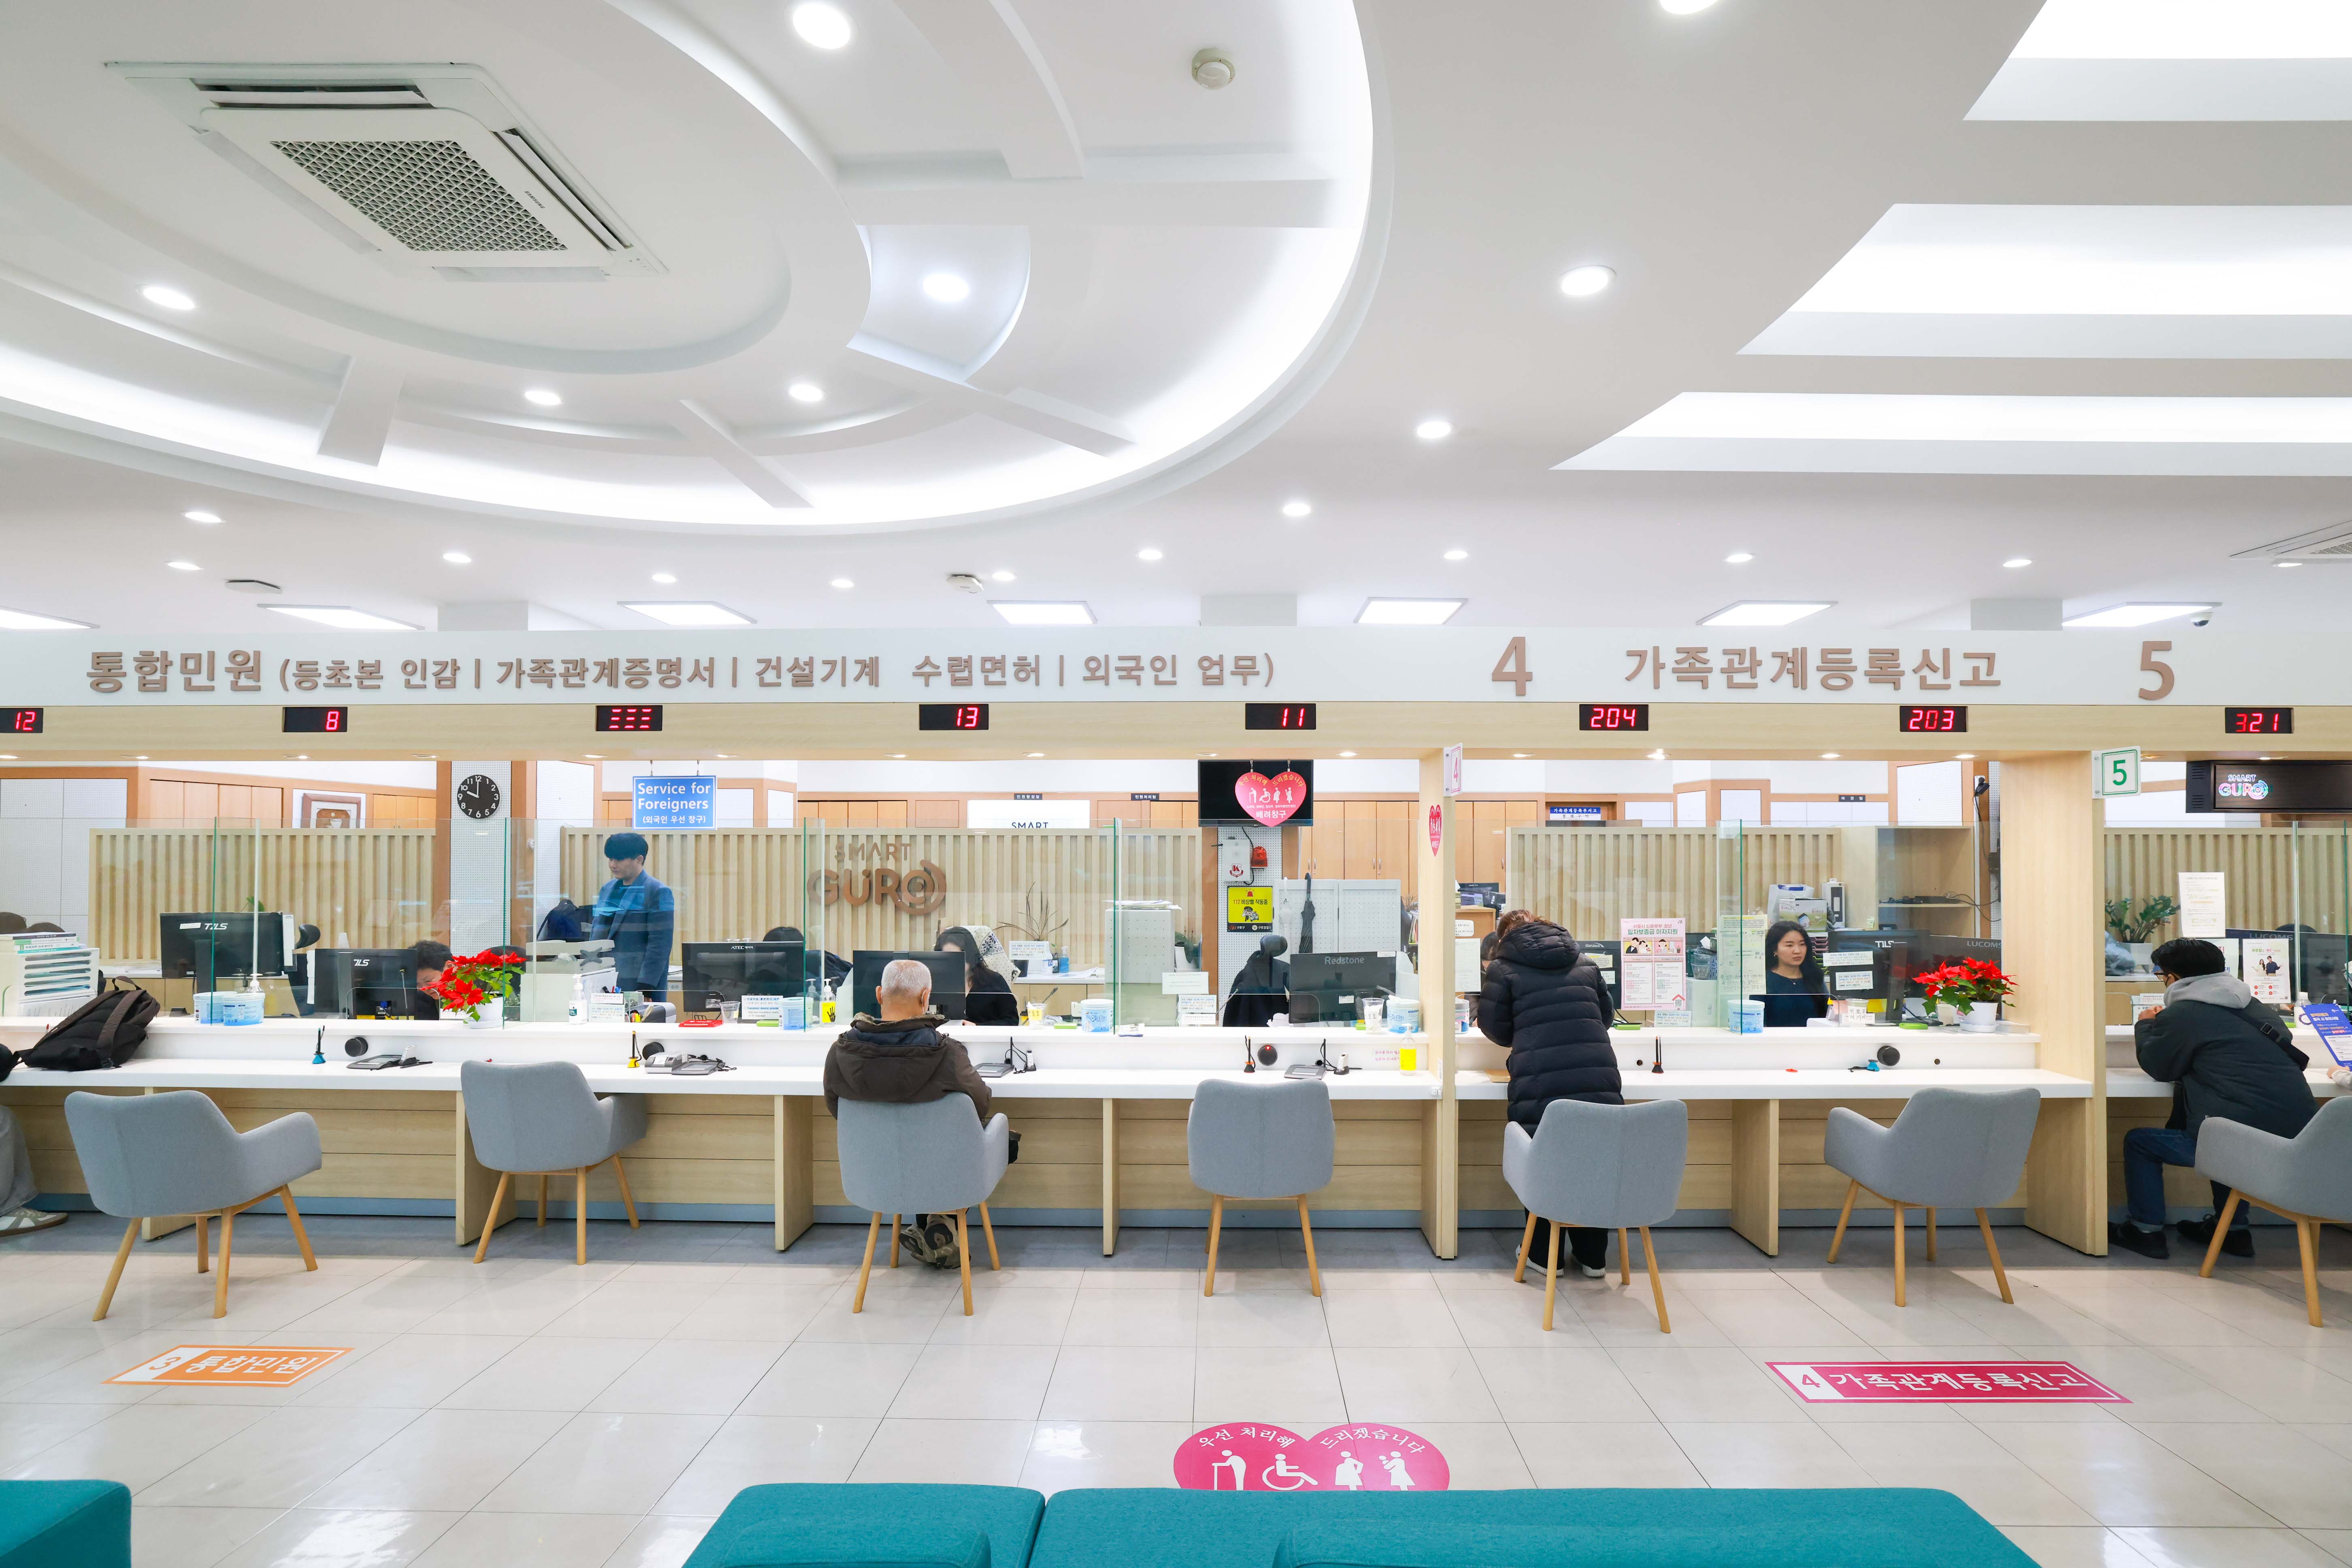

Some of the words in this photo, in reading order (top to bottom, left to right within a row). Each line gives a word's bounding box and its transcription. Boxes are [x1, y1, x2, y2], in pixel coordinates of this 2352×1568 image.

[87, 650, 261, 692] 통합민원
[280, 658, 383, 691] (등초본
[401, 658, 460, 689] 인감
[496, 658, 714, 688] 가족관계증명서
[755, 656, 879, 687] 건설기계
[912, 655, 1040, 686] 수렵면허
[1083, 654, 1177, 686] 외국인
[1198, 653, 1273, 687] 업무)
[1492, 637, 1533, 696] 4
[1625, 646, 2001, 691] 가족관계등록신고
[2139, 641, 2175, 700] 5
[15, 711, 36, 731] 12
[325, 710, 340, 731] 8
[956, 707, 979, 728] 13
[1282, 707, 1305, 727] 11
[1590, 707, 1637, 728] 204
[1908, 709, 1955, 731] 203
[2235, 712, 2280, 732] 321
[1272, 774, 1304, 787] 드리겠습니다
[2112, 759, 2127, 786] 5
[2228, 774, 2257, 782] SMART
[638, 782, 686, 795] Service
[691, 782, 711, 794] for
[2218, 780, 2269, 800] GURO
[638, 798, 709, 813] Foreigners
[1256, 810, 1287, 818] 배려창구
[643, 816, 668, 824] (외국인
[670, 816, 686, 824] 우선
[688, 816, 706, 824] 창구)
[835, 842, 911, 861] SMART
[807, 859, 947, 916] GURO
[1325, 956, 1364, 965] Redstone
[149, 1356, 182, 1371] 3
[185, 1355, 319, 1374] 통합민원
[1801, 1374, 1821, 1387] 4
[1828, 1373, 2089, 1392] 가족관계등록신고
[1199, 1428, 1234, 1449] 우선
[1240, 1426, 1296, 1449] 처리해
[1319, 1427, 1427, 1455] 드리겠습니다
